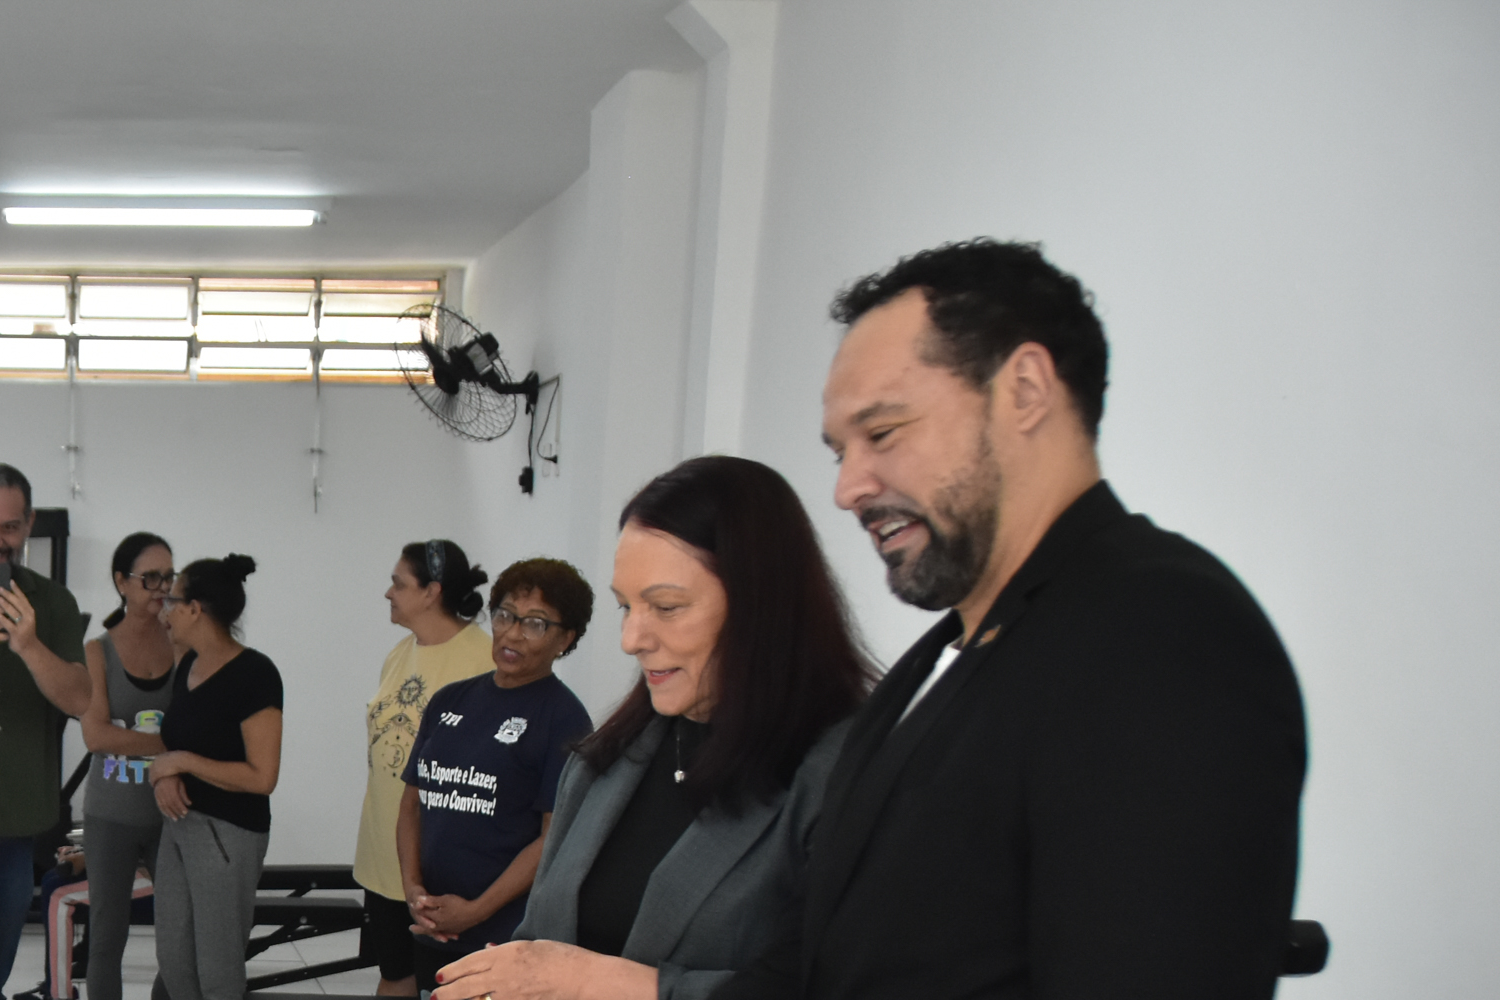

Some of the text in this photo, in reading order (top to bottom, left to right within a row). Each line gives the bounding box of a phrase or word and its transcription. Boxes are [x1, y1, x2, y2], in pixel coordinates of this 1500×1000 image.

[431, 760, 462, 786] Esporte
[462, 769, 469, 785] e
[467, 765, 497, 795] Lazer,
[427, 790, 443, 811] para
[443, 793, 450, 809] o
[449, 789, 497, 817] Conviver!
